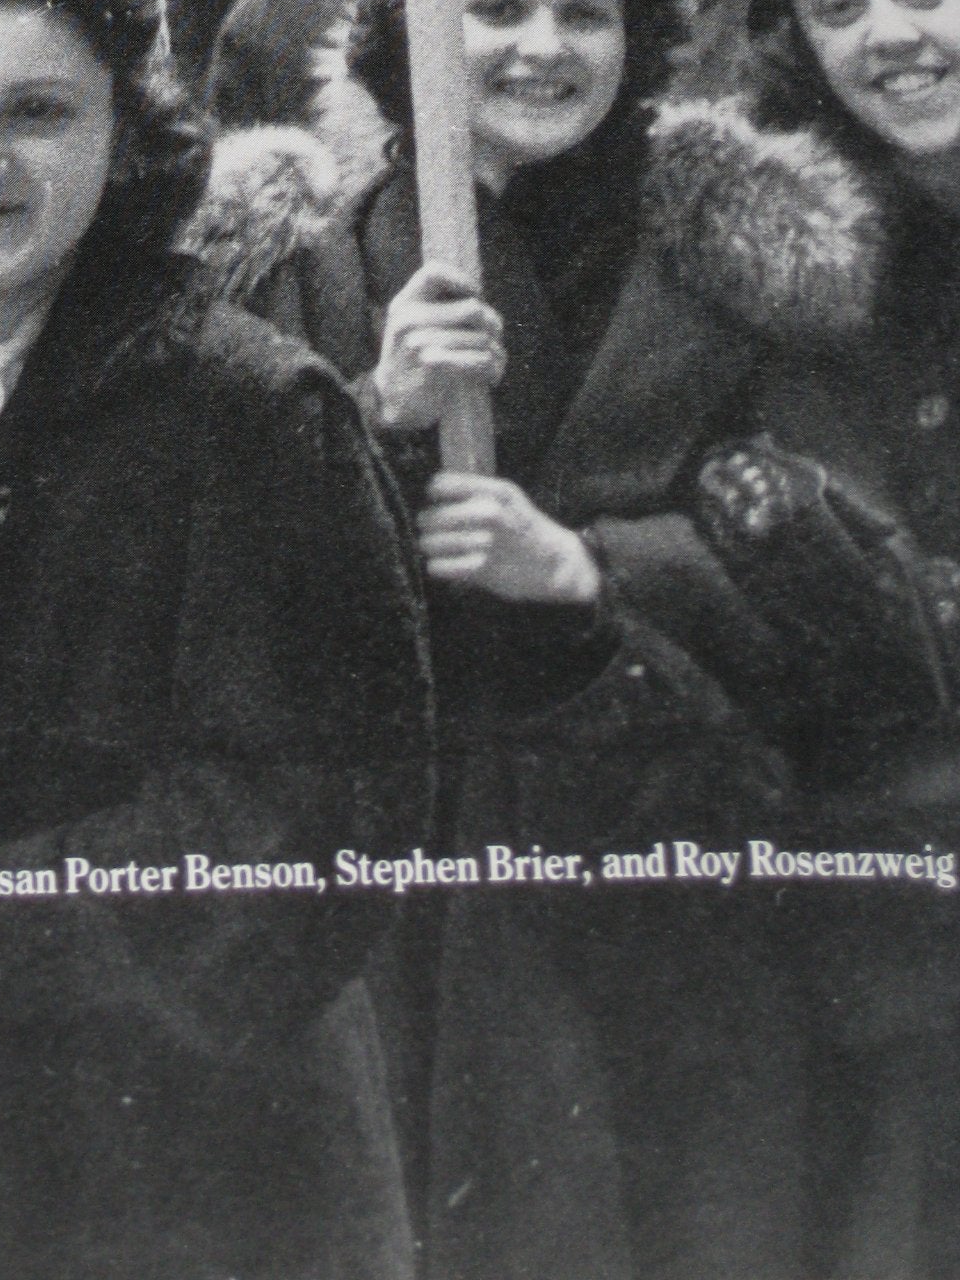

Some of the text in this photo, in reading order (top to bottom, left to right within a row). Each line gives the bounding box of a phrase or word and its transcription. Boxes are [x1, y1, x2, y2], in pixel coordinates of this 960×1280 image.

[64, 857, 178, 894] Porter
[184, 854, 326, 893] Benson,
[336, 848, 480, 893] Stephen
[486, 845, 592, 886] Brier,
[602, 842, 666, 879] and
[672, 841, 740, 885] Roy
[749, 840, 957, 888] Rosenzweig
